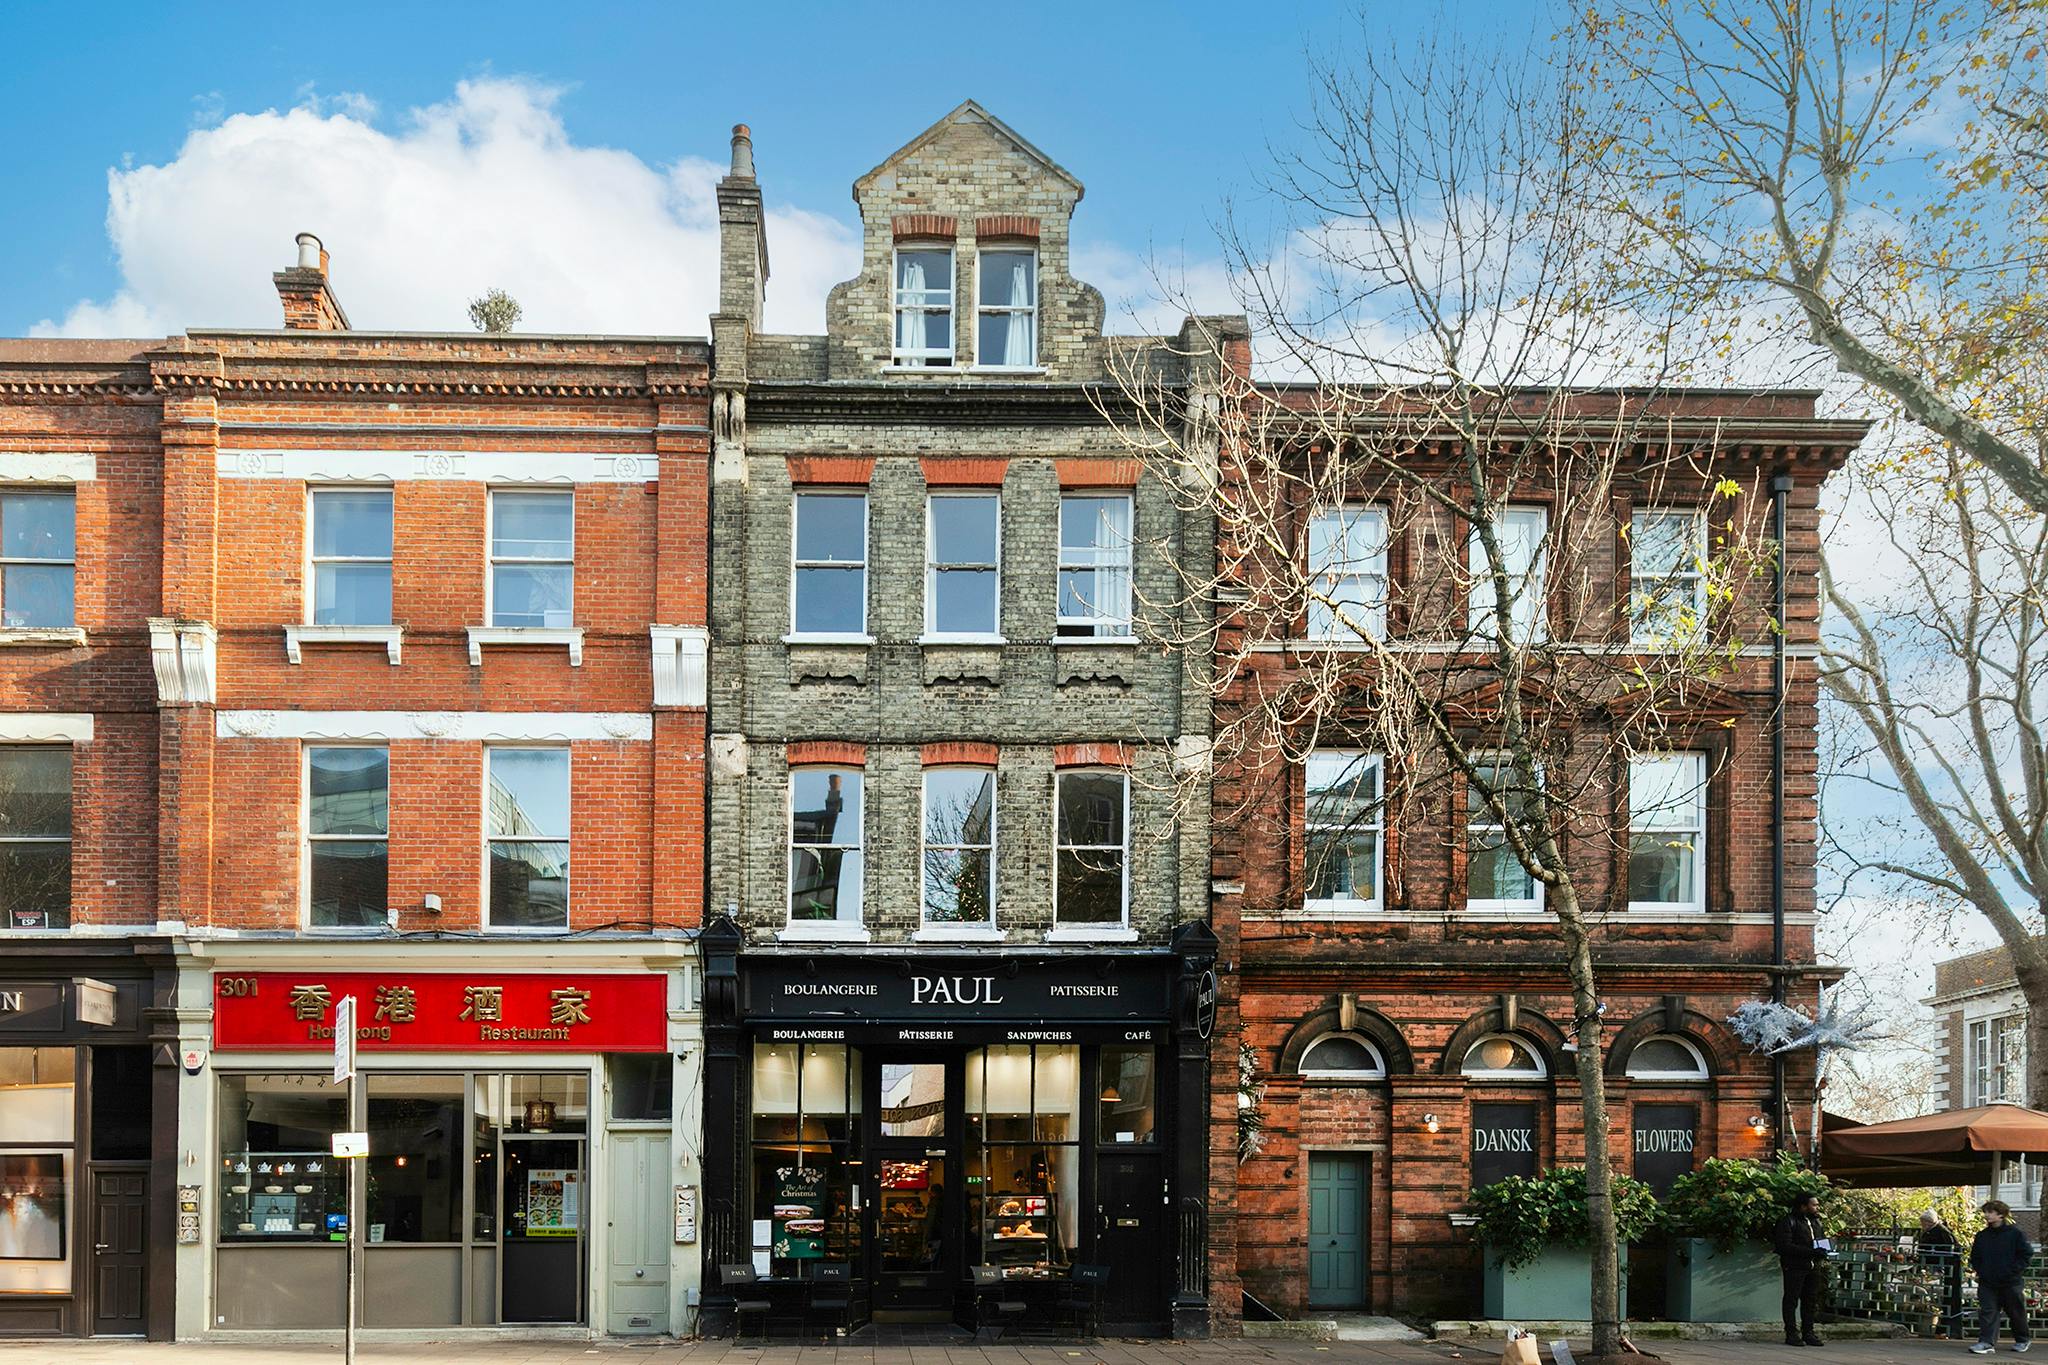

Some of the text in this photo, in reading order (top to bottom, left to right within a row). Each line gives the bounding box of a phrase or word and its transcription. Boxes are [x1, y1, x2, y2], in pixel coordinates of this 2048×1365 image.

[22, 918, 36, 926] ESP
[220, 978, 258, 997] 301
[784, 976, 1120, 1004] BOULANGERIE PAUL PATISSERIE
[0, 991, 22, 1011] N
[288, 983, 592, 1026] 香港酒家
[481, 1024, 571, 1041] Restaurant
[772, 1030, 845, 1040] BOULANGERIE
[1007, 1031, 1072, 1041] SANDWICHES
[1125, 1029, 1152, 1040] CAFÉ
[1474, 1128, 1533, 1152] DANSK
[1635, 1129, 1694, 1152] FLOWERS
[781, 1190, 817, 1198] Christmas
